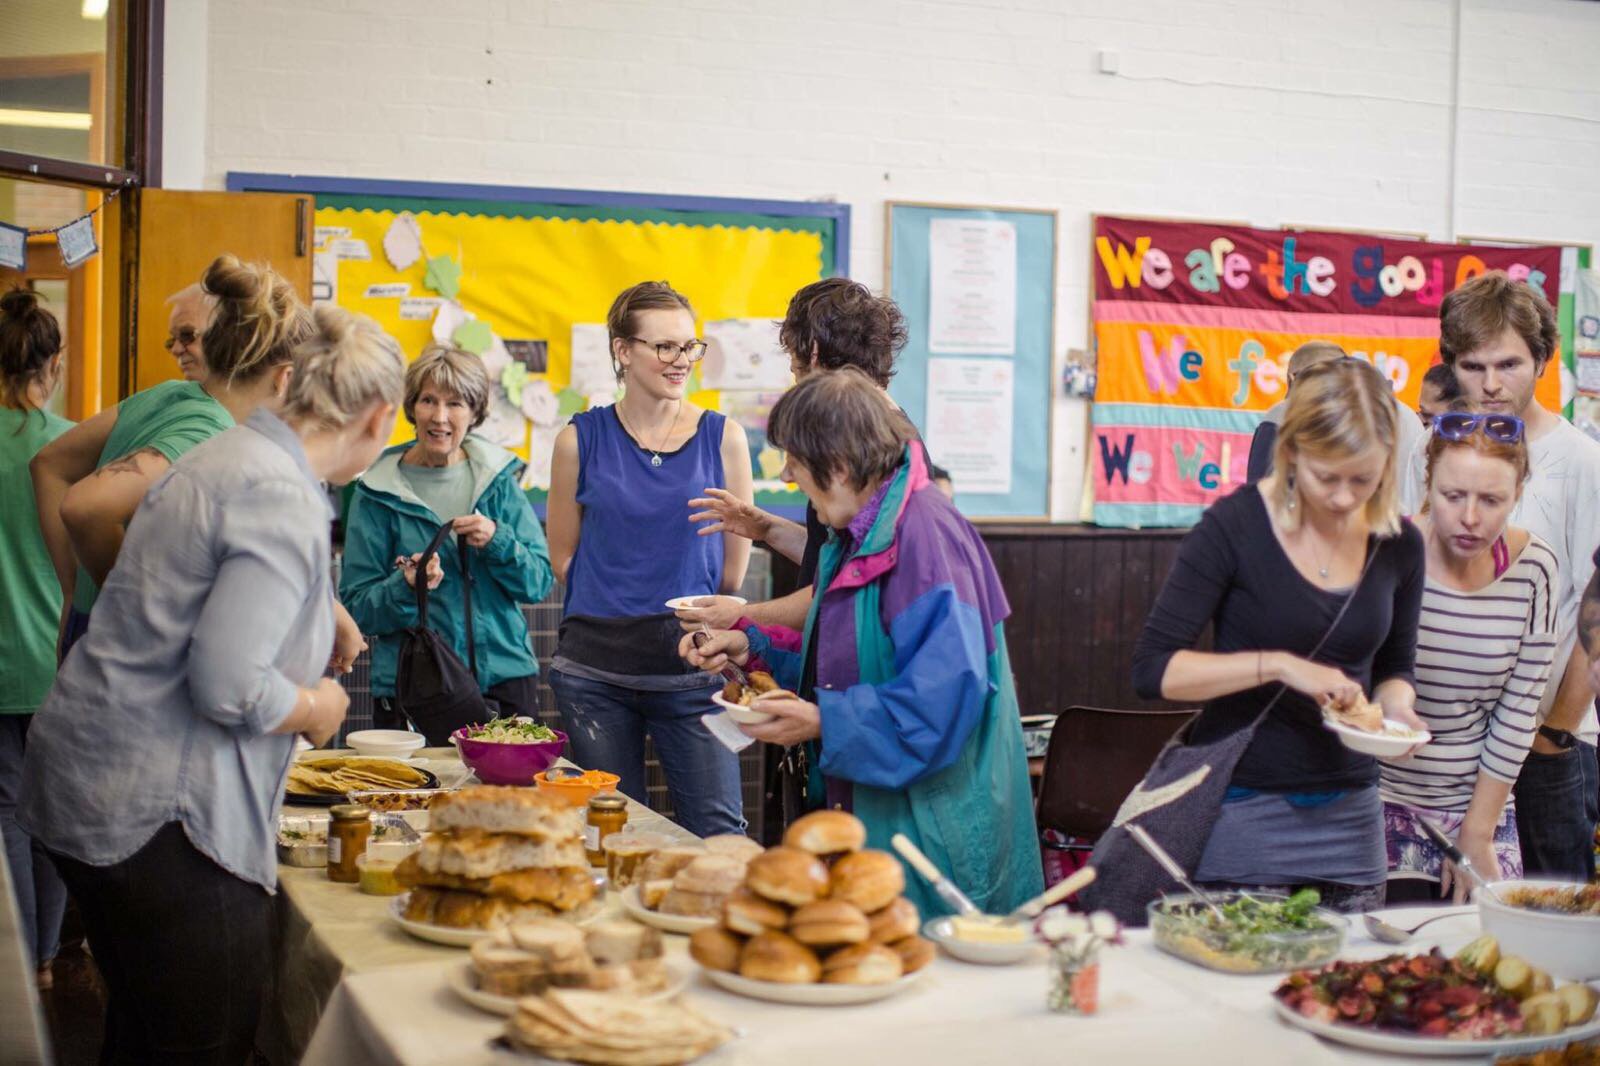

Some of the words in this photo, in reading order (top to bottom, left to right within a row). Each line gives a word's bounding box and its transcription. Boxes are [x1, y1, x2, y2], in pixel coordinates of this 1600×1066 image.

[1096, 237, 1175, 290] We
[1185, 237, 1251, 293] are
[1259, 236, 1337, 299] the
[1351, 246, 1444, 307] good
[1137, 330, 1204, 395] We
[1098, 434, 1153, 486] We
